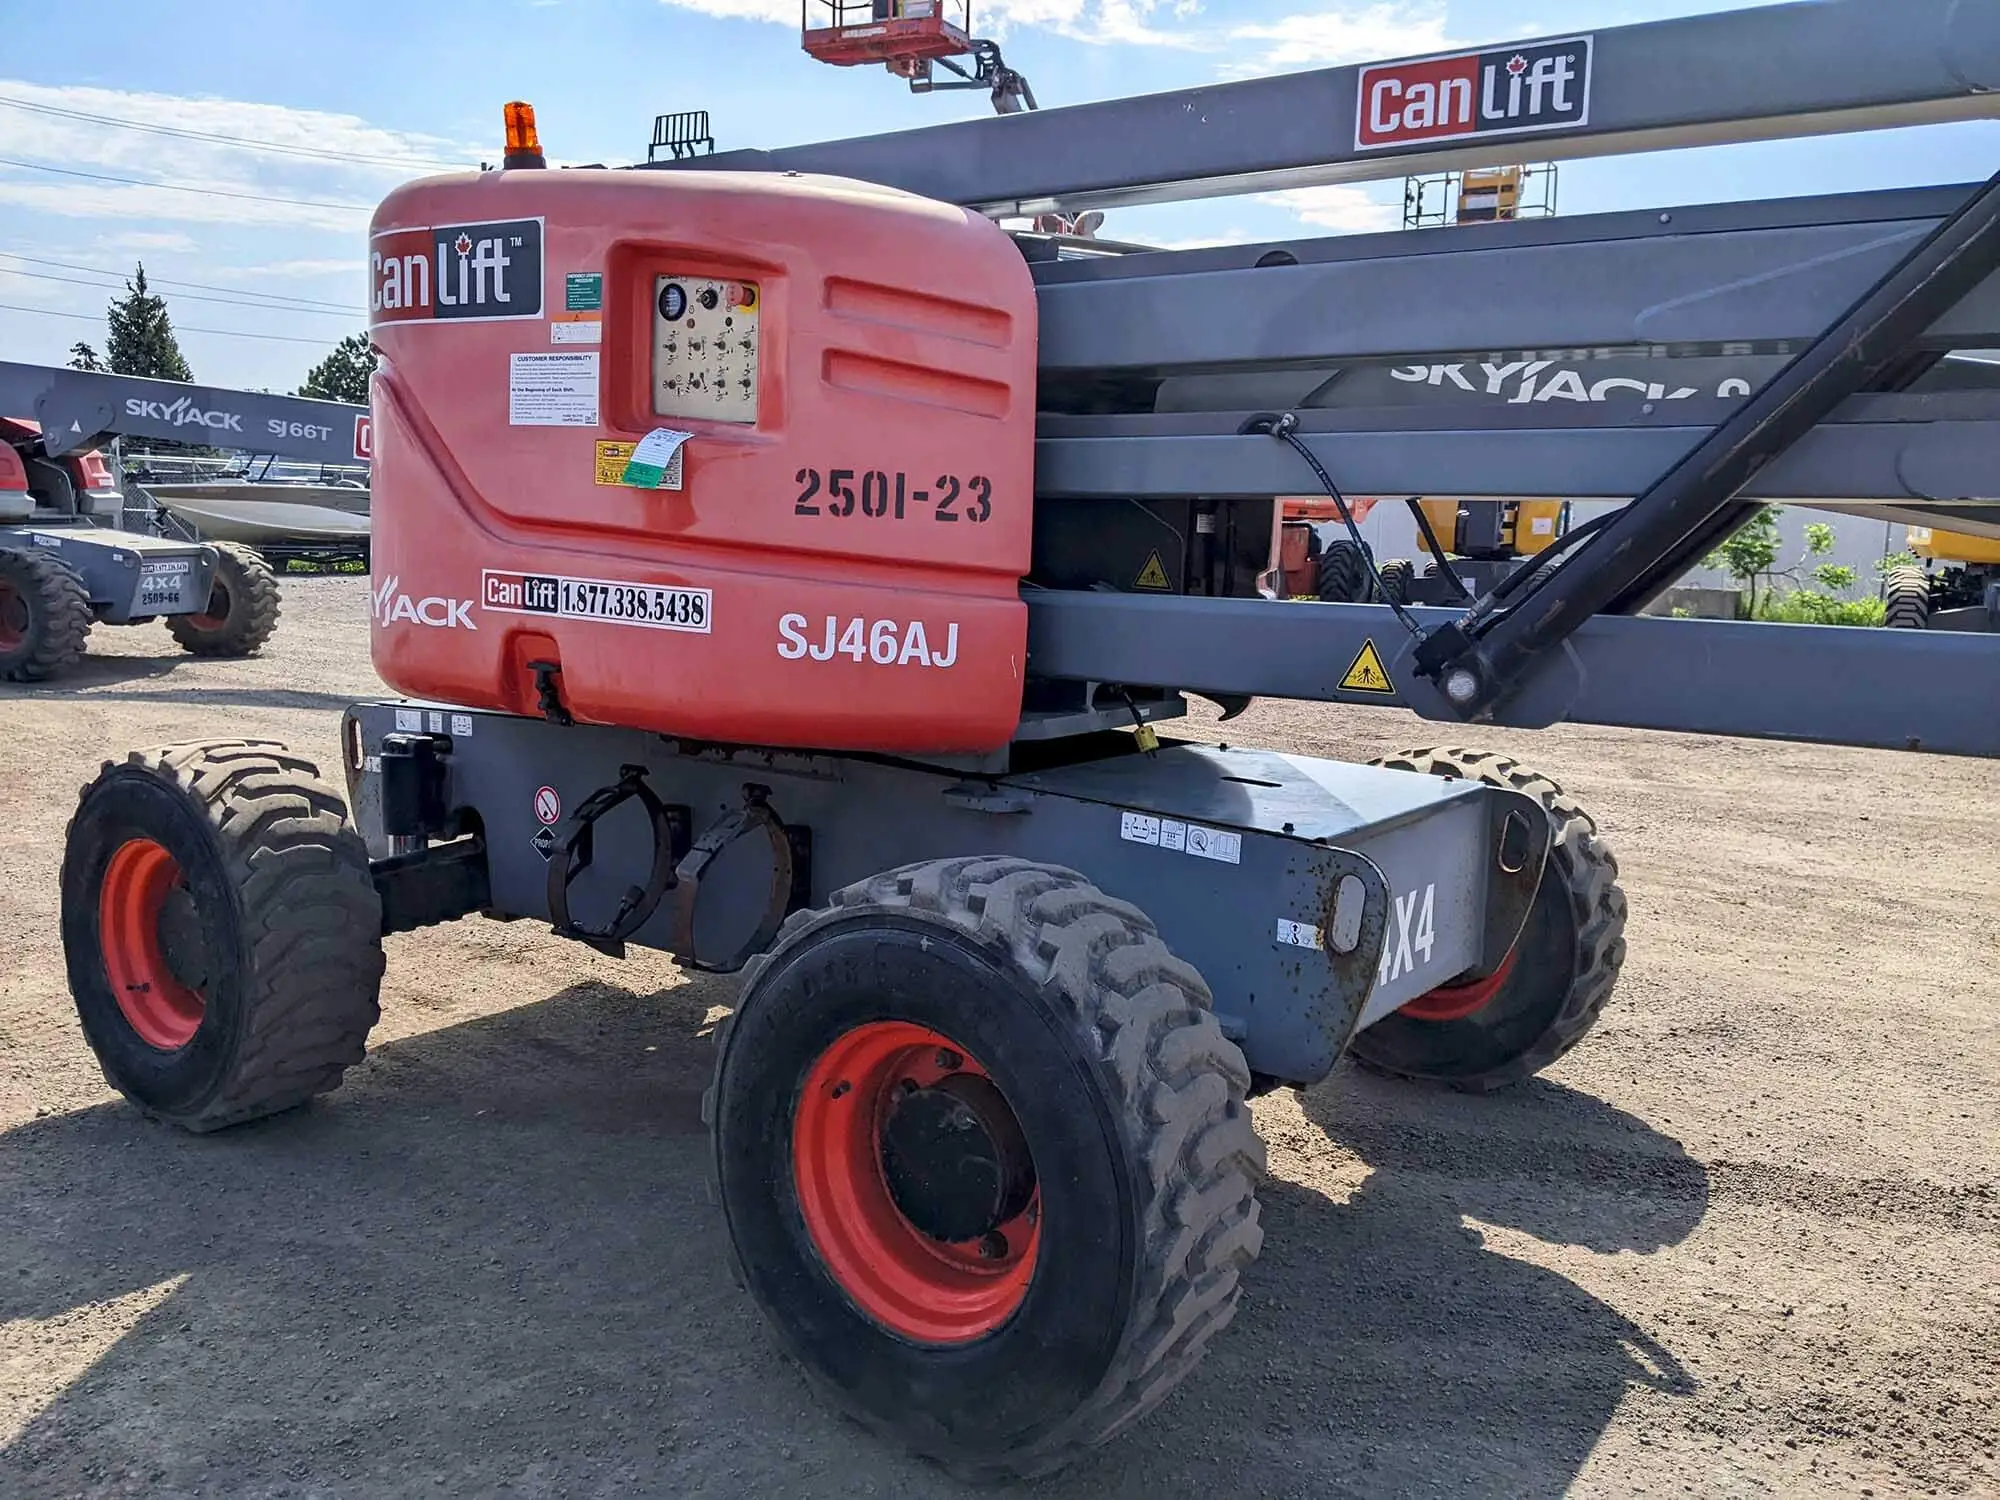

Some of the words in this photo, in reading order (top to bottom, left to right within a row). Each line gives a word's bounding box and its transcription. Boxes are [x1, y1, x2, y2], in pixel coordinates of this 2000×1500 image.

[125, 396, 244, 433] SKYJACK
[267, 419, 333, 441] SJ66T
[794, 467, 992, 523] 2501-23
[142, 592, 180, 606] 2509-66
[562, 582, 705, 626] 1.877.338.5438
[776, 613, 959, 668] SJ46AJ
